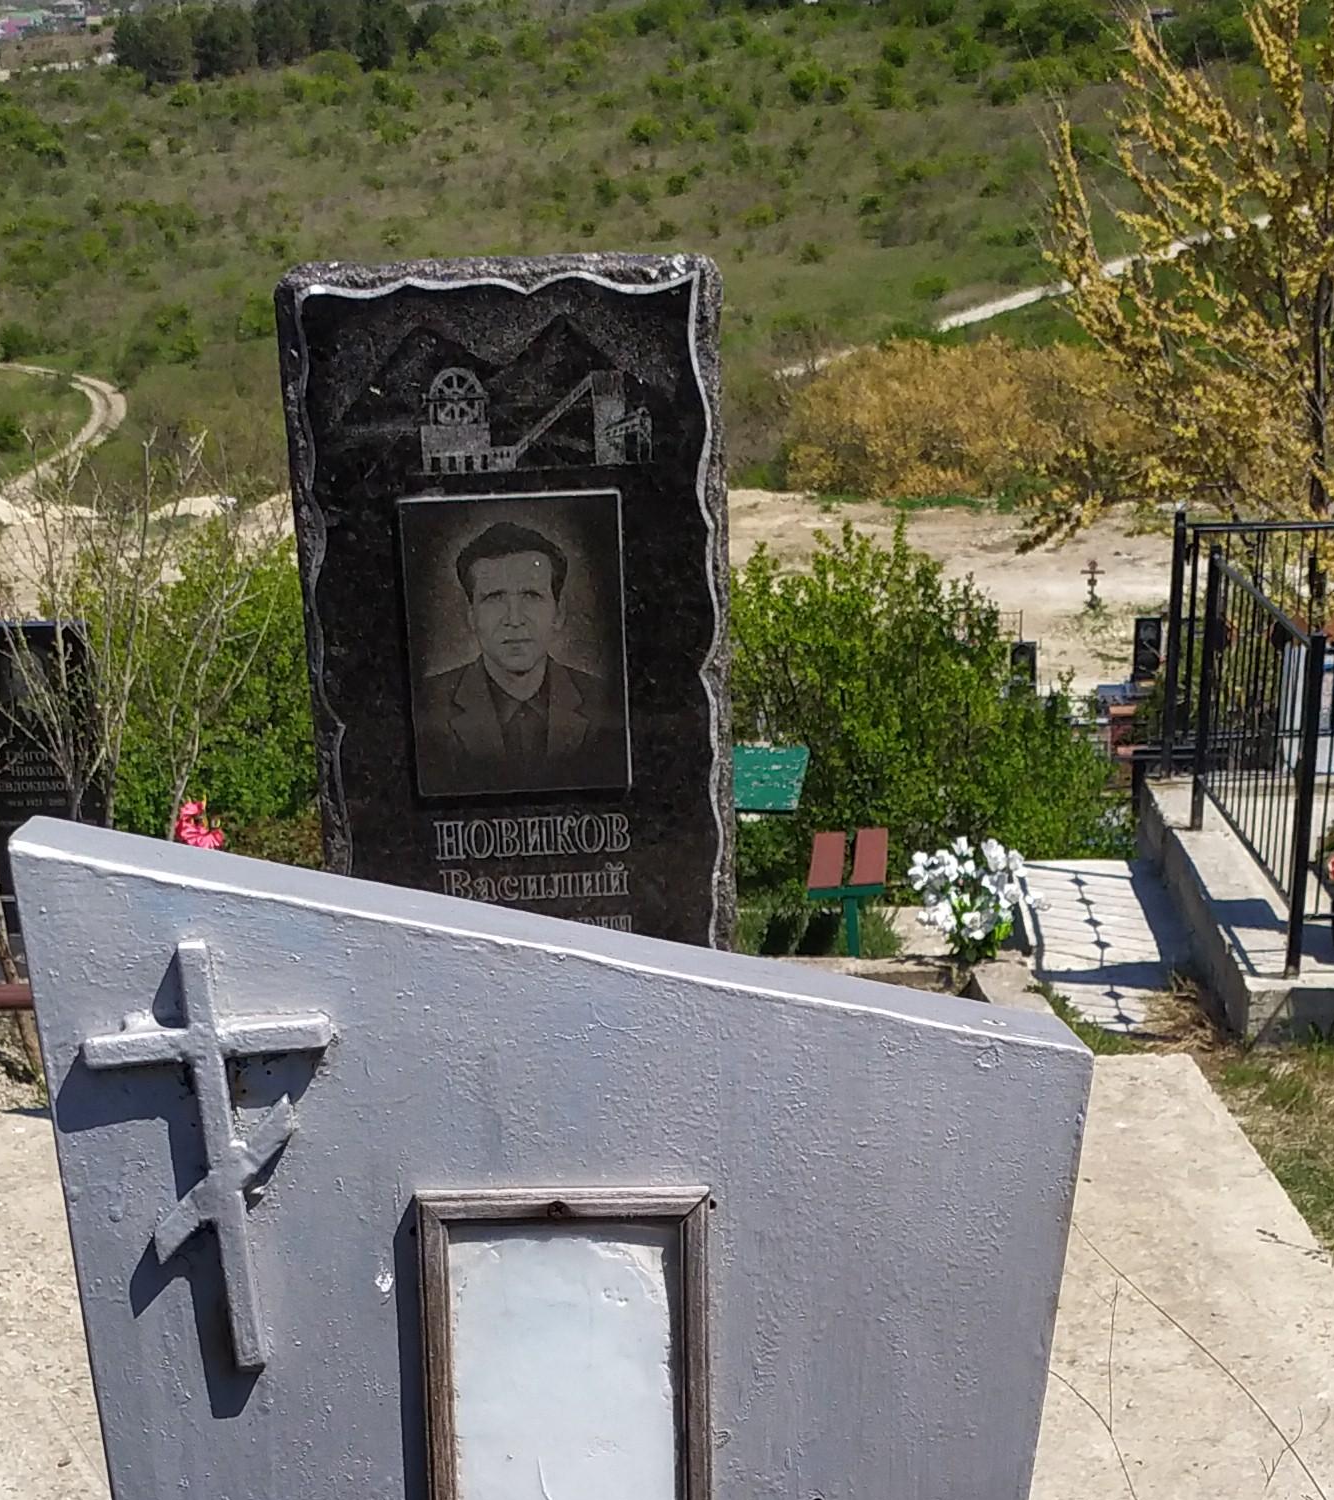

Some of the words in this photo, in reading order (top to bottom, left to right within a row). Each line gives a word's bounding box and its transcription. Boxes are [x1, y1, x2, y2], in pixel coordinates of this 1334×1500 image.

[10, 764, 69, 777] НИКОЛА
[433, 812, 631, 861] НОВИКОВ
[440, 861, 630, 902] Василий
